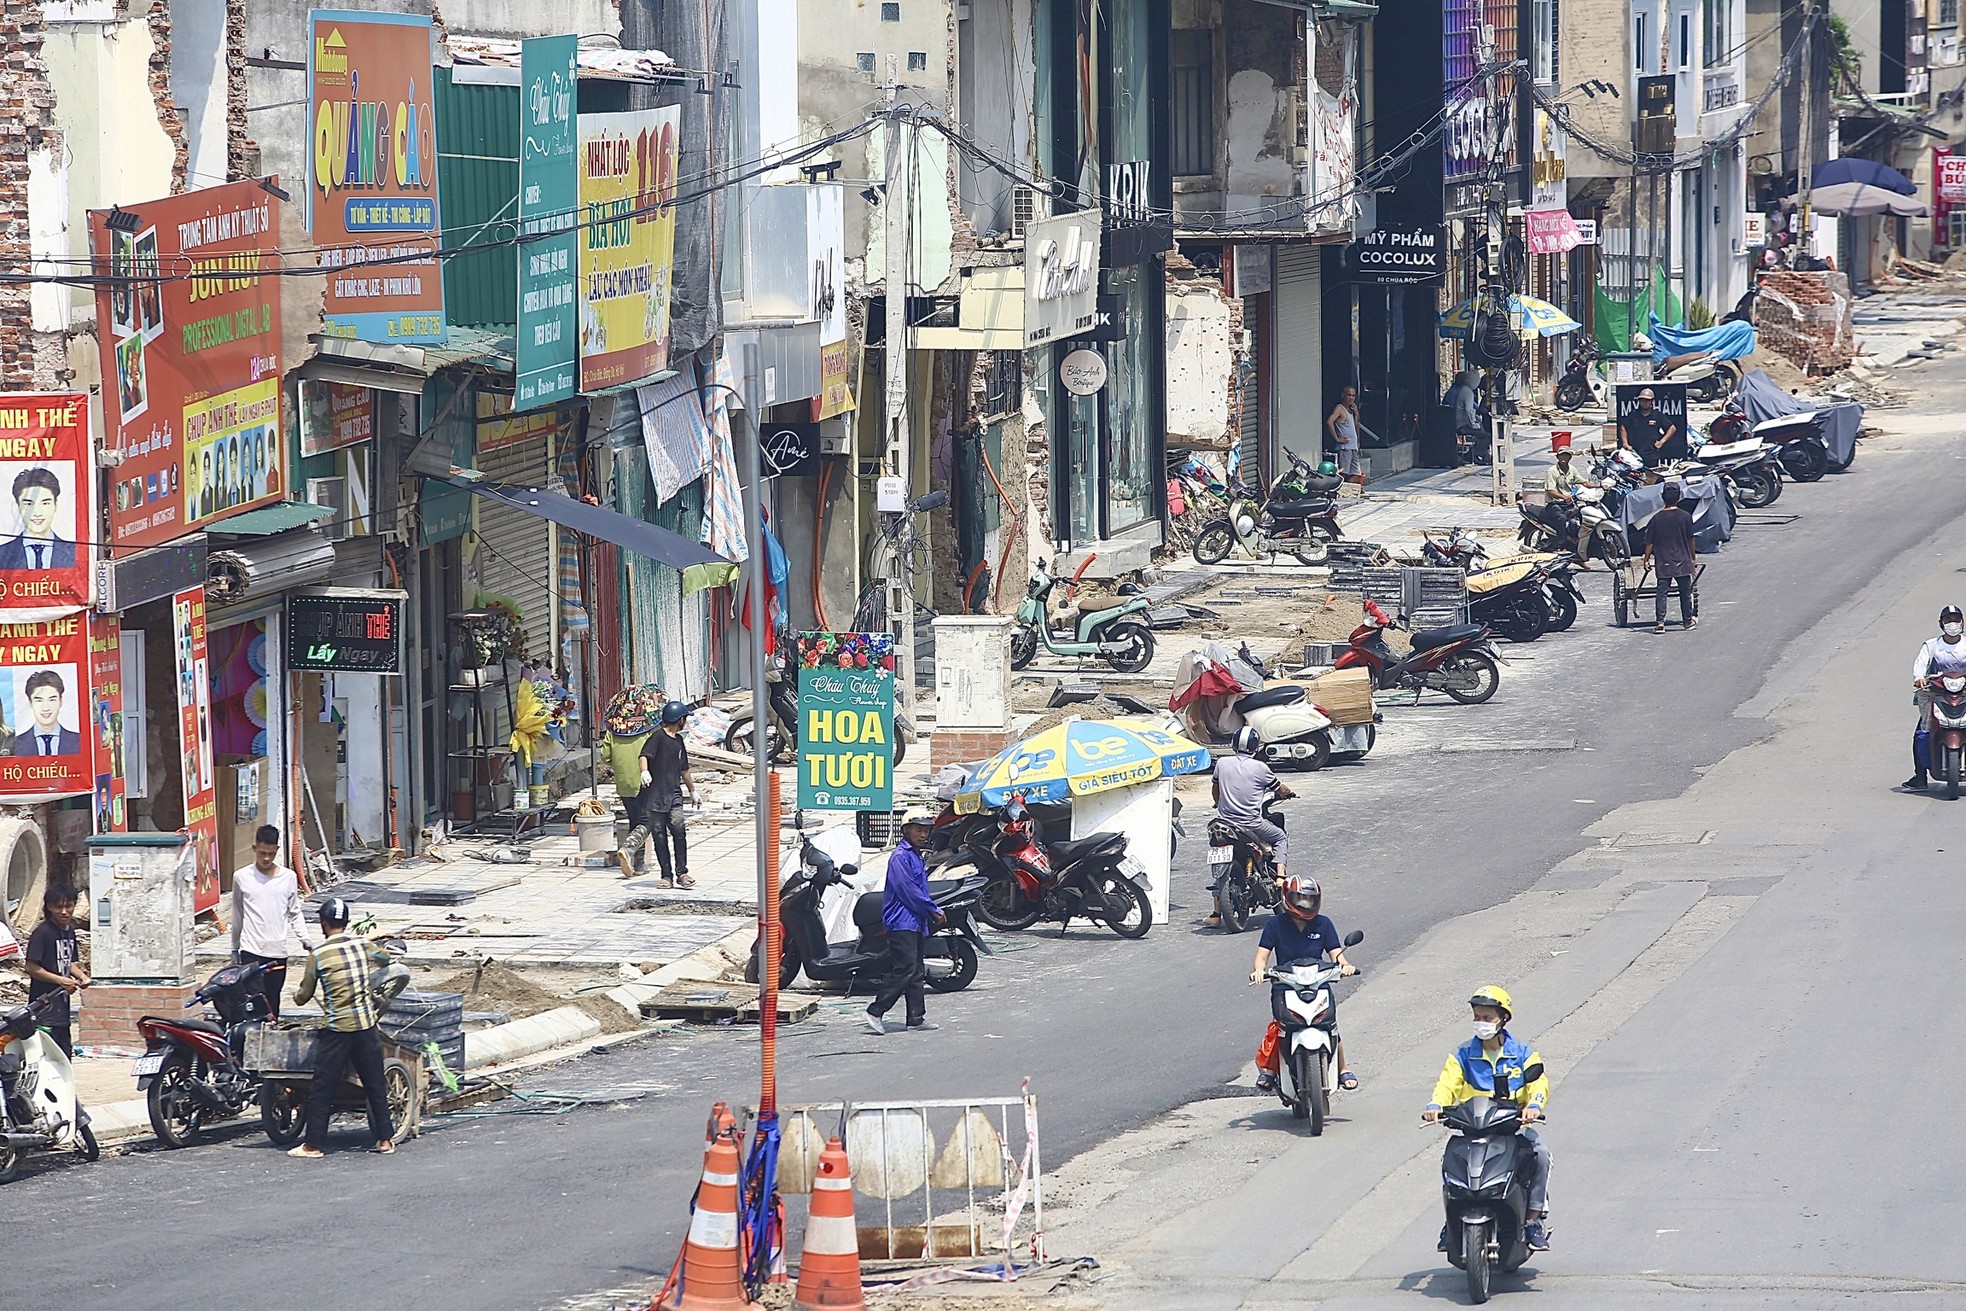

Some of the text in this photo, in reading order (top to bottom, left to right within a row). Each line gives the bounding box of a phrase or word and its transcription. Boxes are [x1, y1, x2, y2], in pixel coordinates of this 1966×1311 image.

[315, 69, 433, 198] QUẢNG CÁO
[587, 128, 631, 185] NHẤT LỘC
[178, 221, 201, 250] TRUNG
[202, 210, 217, 246] TÂM
[217, 204, 230, 241] ẢNH
[241, 201, 260, 239] THUẬT
[1364, 227, 1435, 247] MỸ PHẨM
[1360, 251, 1437, 266] COCOLUX
[189, 256, 223, 303] JUN
[36, 400, 78, 429] THẺ
[1652, 392, 1682, 416] HẨM
[187, 411, 207, 444] CHỤP
[208, 400, 224, 435] ẢNH
[0, 438, 57, 458] NGAY
[366, 604, 391, 640] THẺ
[12, 644, 62, 663] NGAY
[307, 643, 379, 663] Lấy Ngay
[810, 675, 845, 693] Châu
[808, 709, 886, 744] HOA
[1012, 748, 1056, 772] be
[1070, 736, 1129, 761] be
[805, 751, 885, 788] TƯƠI
[1079, 760, 1154, 791] GIÁ SIÊU TỐT
[1170, 754, 1197, 772] ĐẶT XE
[1032, 785, 1049, 797] XE
